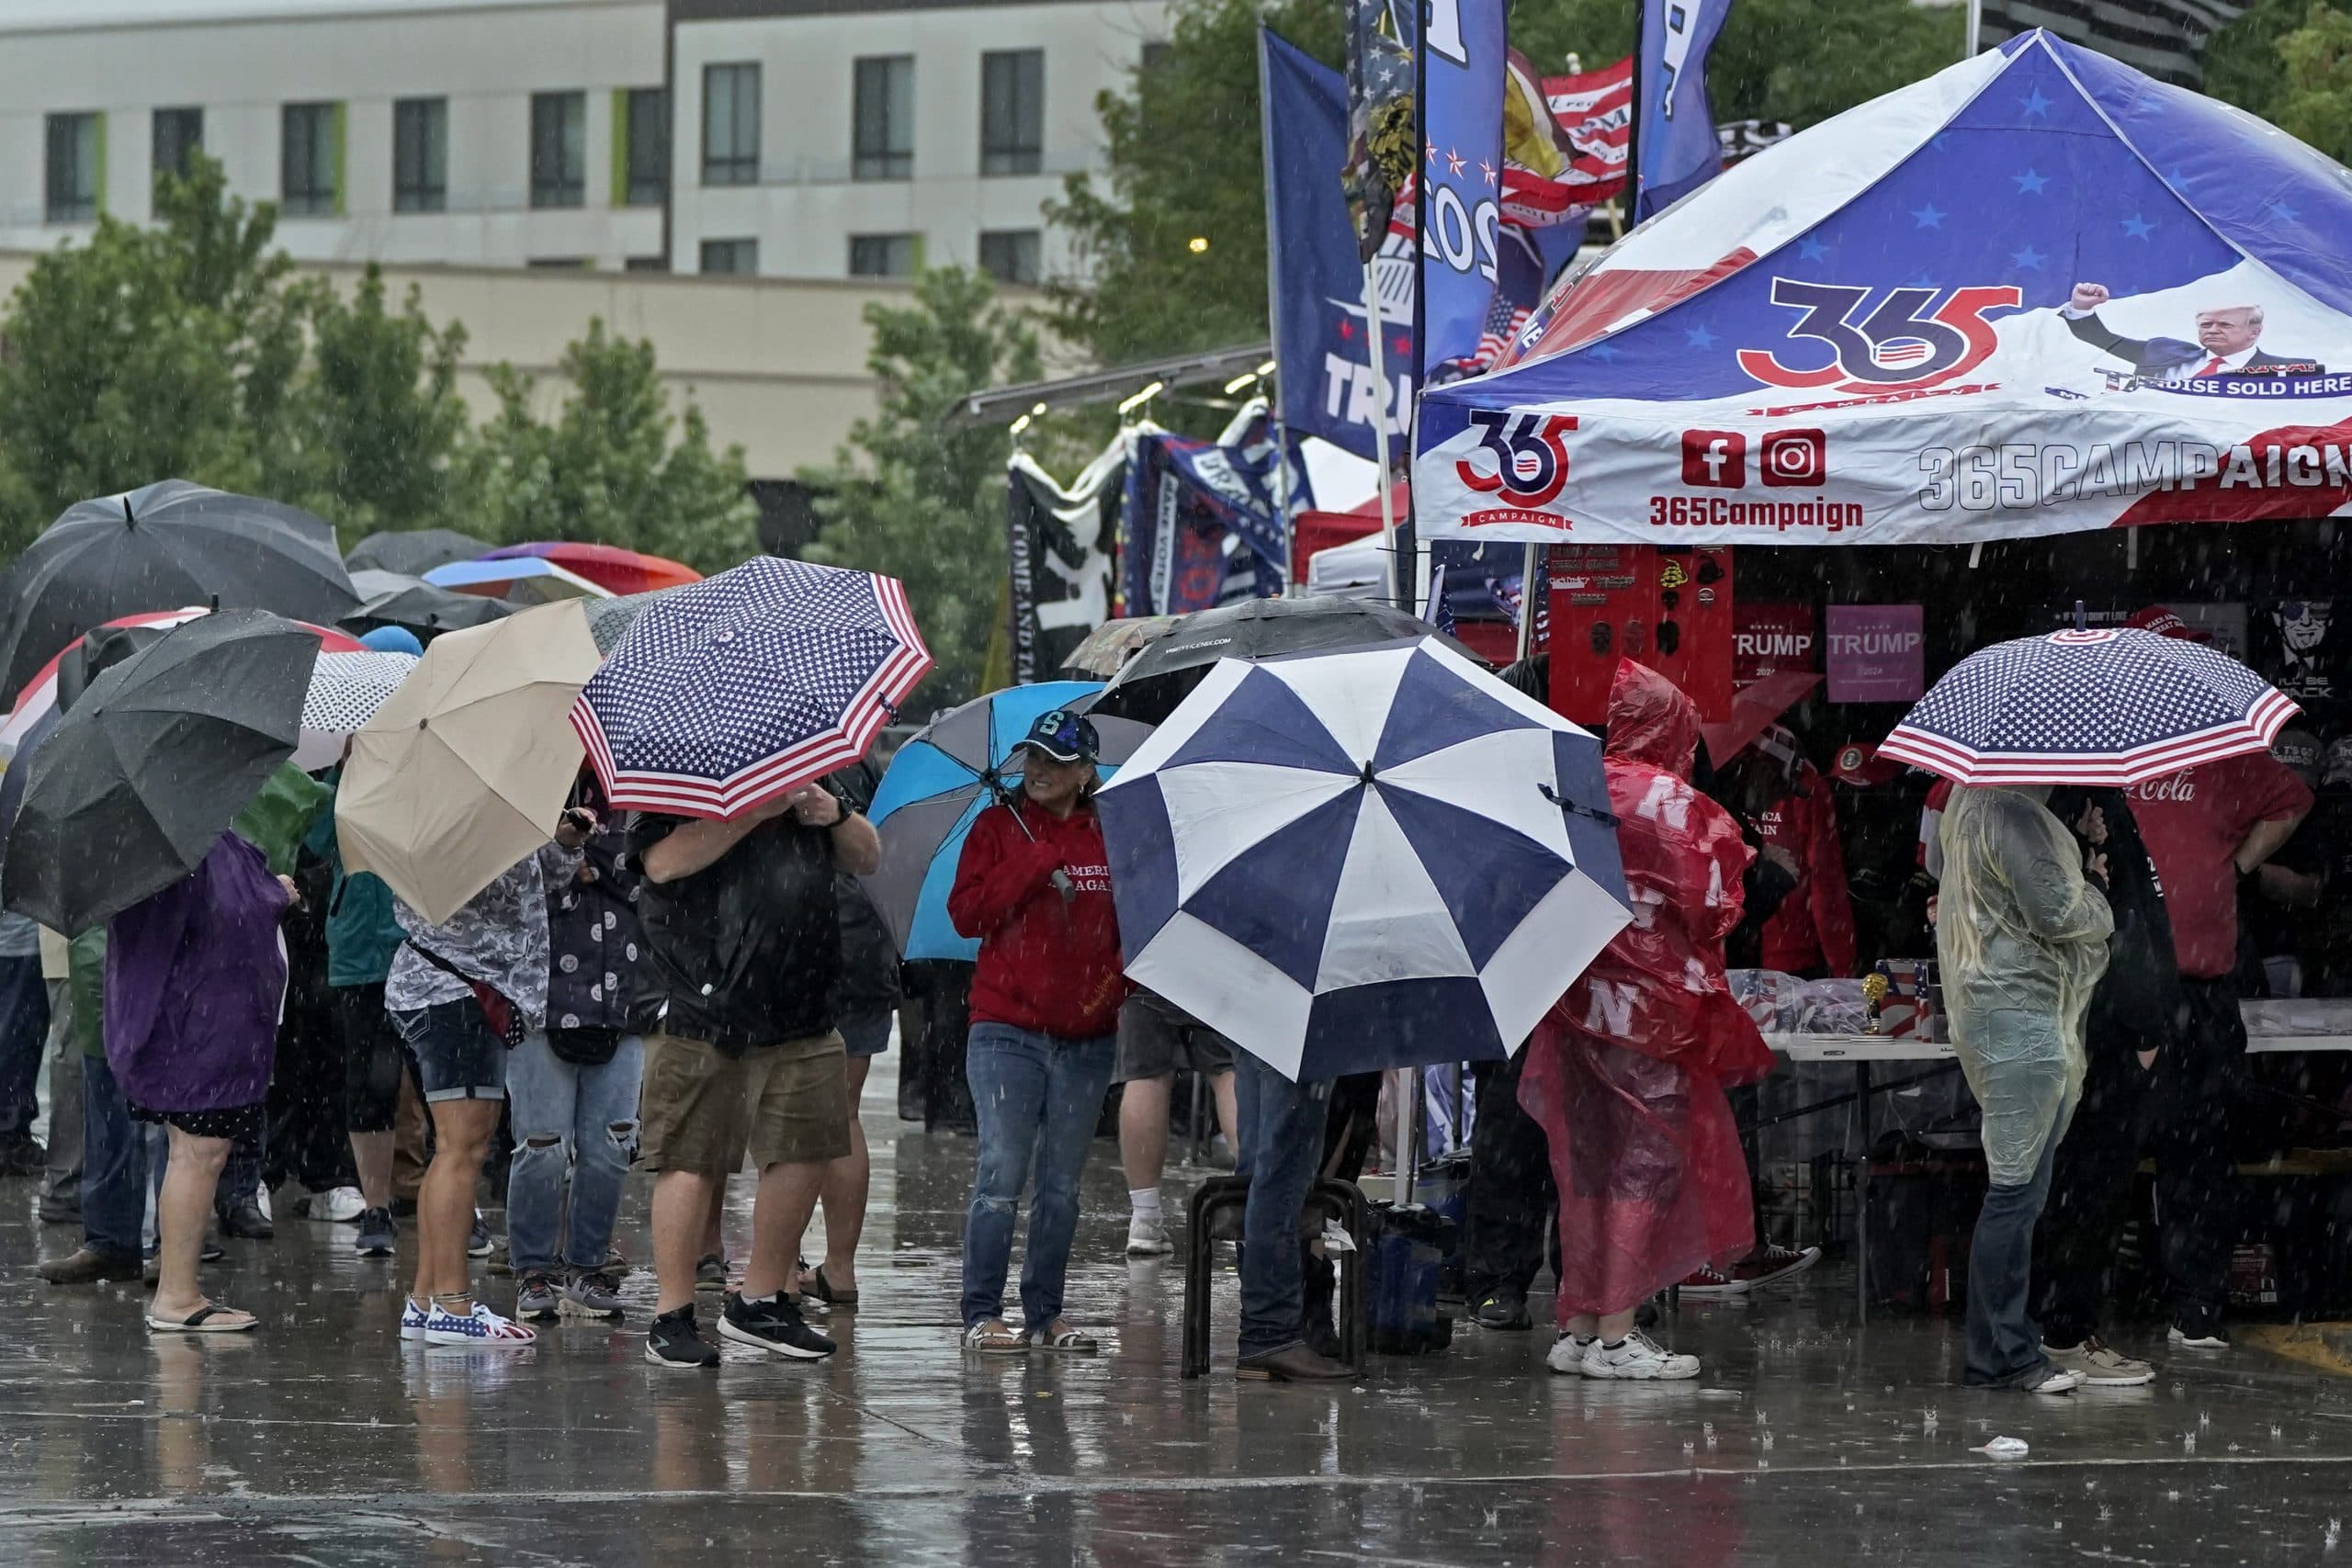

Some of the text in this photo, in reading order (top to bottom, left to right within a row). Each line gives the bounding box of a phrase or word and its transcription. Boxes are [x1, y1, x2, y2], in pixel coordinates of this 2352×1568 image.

[1736, 276, 2023, 395] 365
[2226, 381, 2287, 396] SOLD
[2294, 376, 2352, 395] HERE
[1455, 409, 1579, 509] 365
[1918, 441, 2352, 513] 365CAMPAIGN
[1477, 511, 1557, 525] CAMPAIGN
[1650, 495, 1863, 532] 365Campaign
[1013, 524, 1032, 593] COME
[1016, 603, 1033, 647] AND
[1827, 631, 1921, 655] TRUMP
